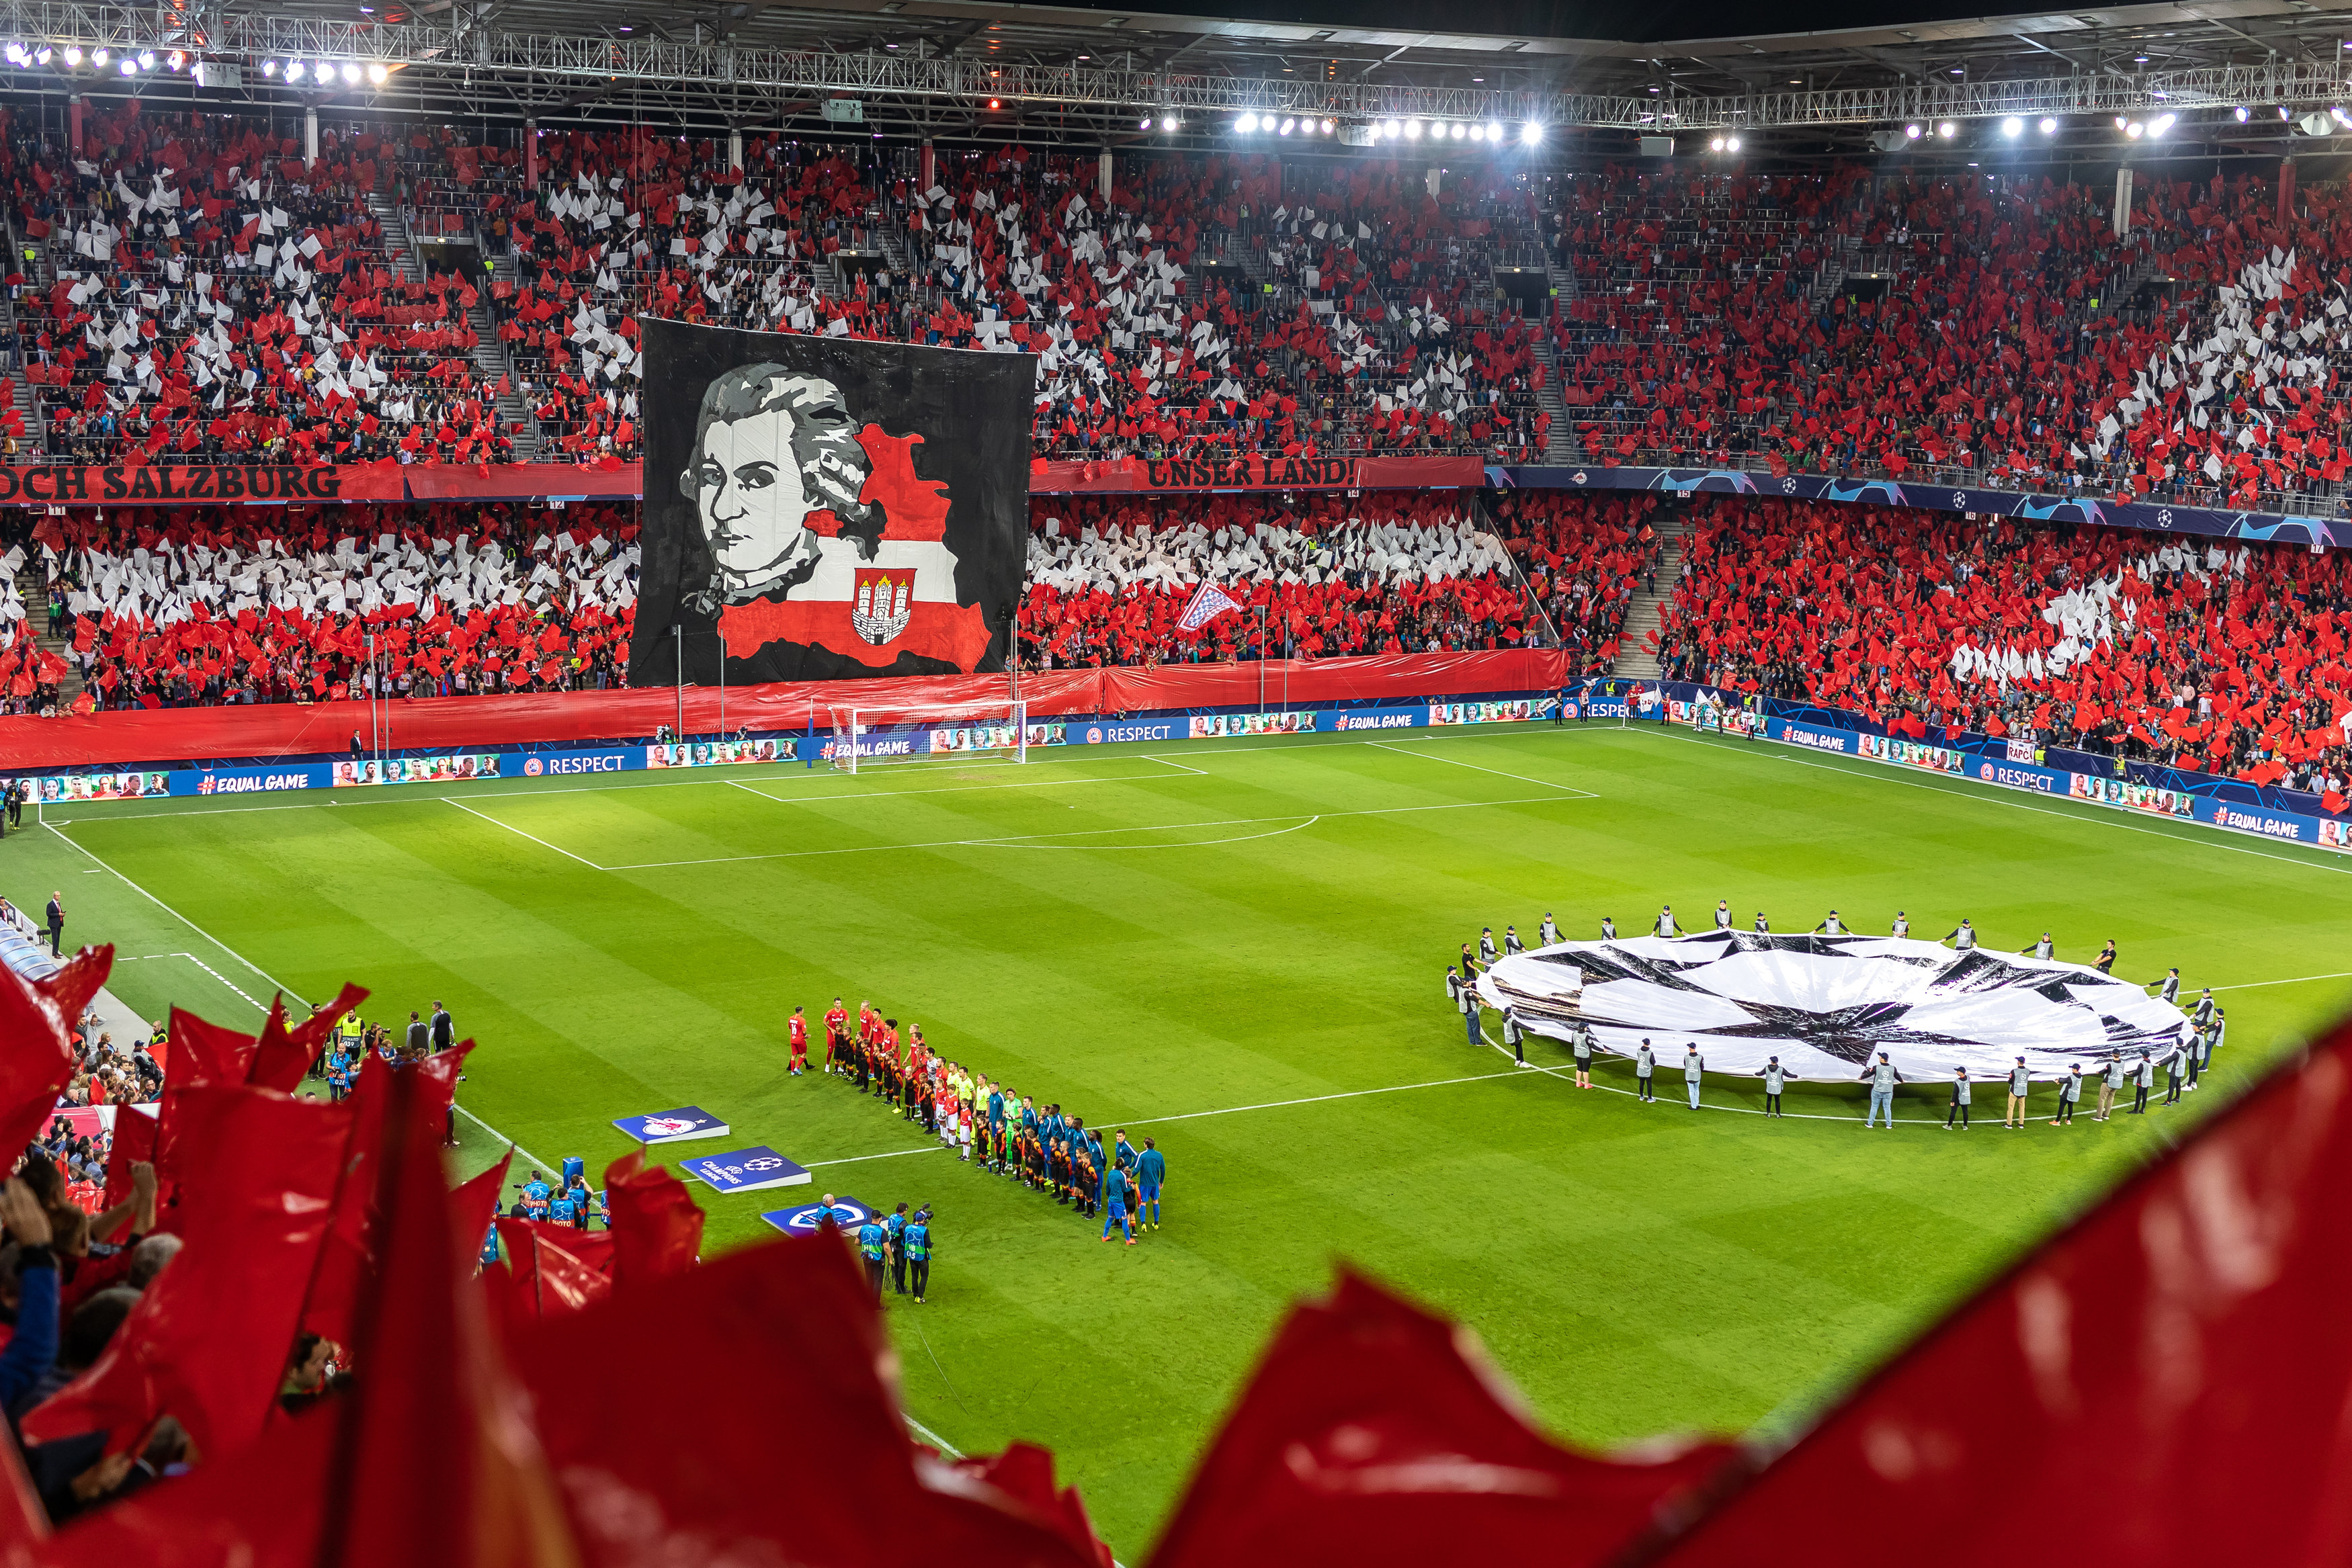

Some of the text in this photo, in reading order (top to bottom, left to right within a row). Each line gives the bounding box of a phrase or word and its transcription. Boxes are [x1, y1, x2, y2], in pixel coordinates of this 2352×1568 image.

[1146, 458, 1355, 487] UNSER LAND!
[103, 466, 341, 500] SALZBURG
[2312, 544, 2322, 553] 17
[1107, 726, 1171, 742] RESPECT
[550, 755, 625, 774] RESPECT
[1999, 767, 2054, 791] RESPECT
[791, 1024, 797, 1035] 16
[699, 1168, 722, 1182] LEAGUE
[702, 1161, 743, 1184] CHAMPIONS
[552, 1219, 571, 1227] PHOTO
